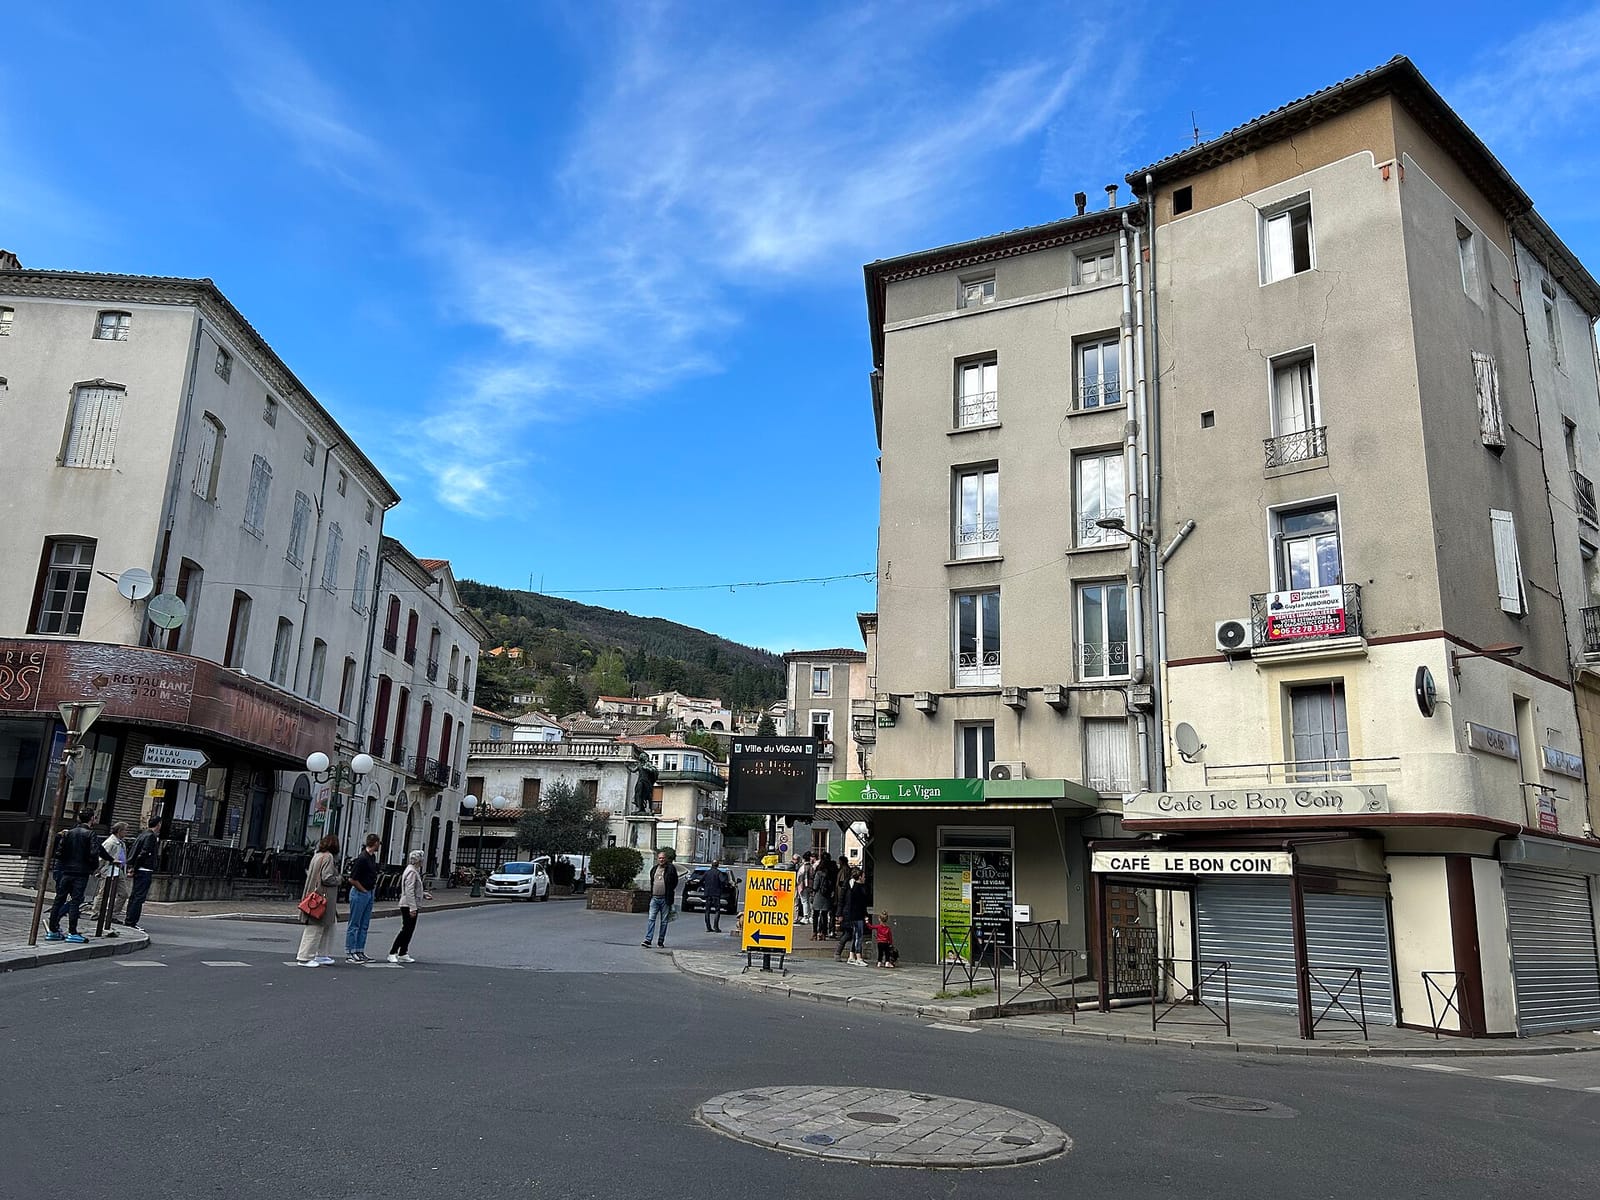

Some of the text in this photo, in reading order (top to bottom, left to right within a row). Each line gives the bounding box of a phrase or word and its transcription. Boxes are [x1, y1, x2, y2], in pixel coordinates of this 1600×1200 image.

[113, 674, 189, 692] RESTAURANT
[142, 687, 157, 697] 20
[148, 748, 181, 757] MILLAU
[146, 756, 199, 767] MANDAGOUT
[898, 785, 911, 797] Le
[913, 785, 941, 799] Vigan
[1157, 790, 1344, 814] Cafe Le Bon Coin
[1110, 855, 1272, 872] CAFÉ LE BON COIN
[749, 877, 792, 892] MARCHE
[761, 895, 777, 907] DES
[748, 910, 789, 926] POTIERS
